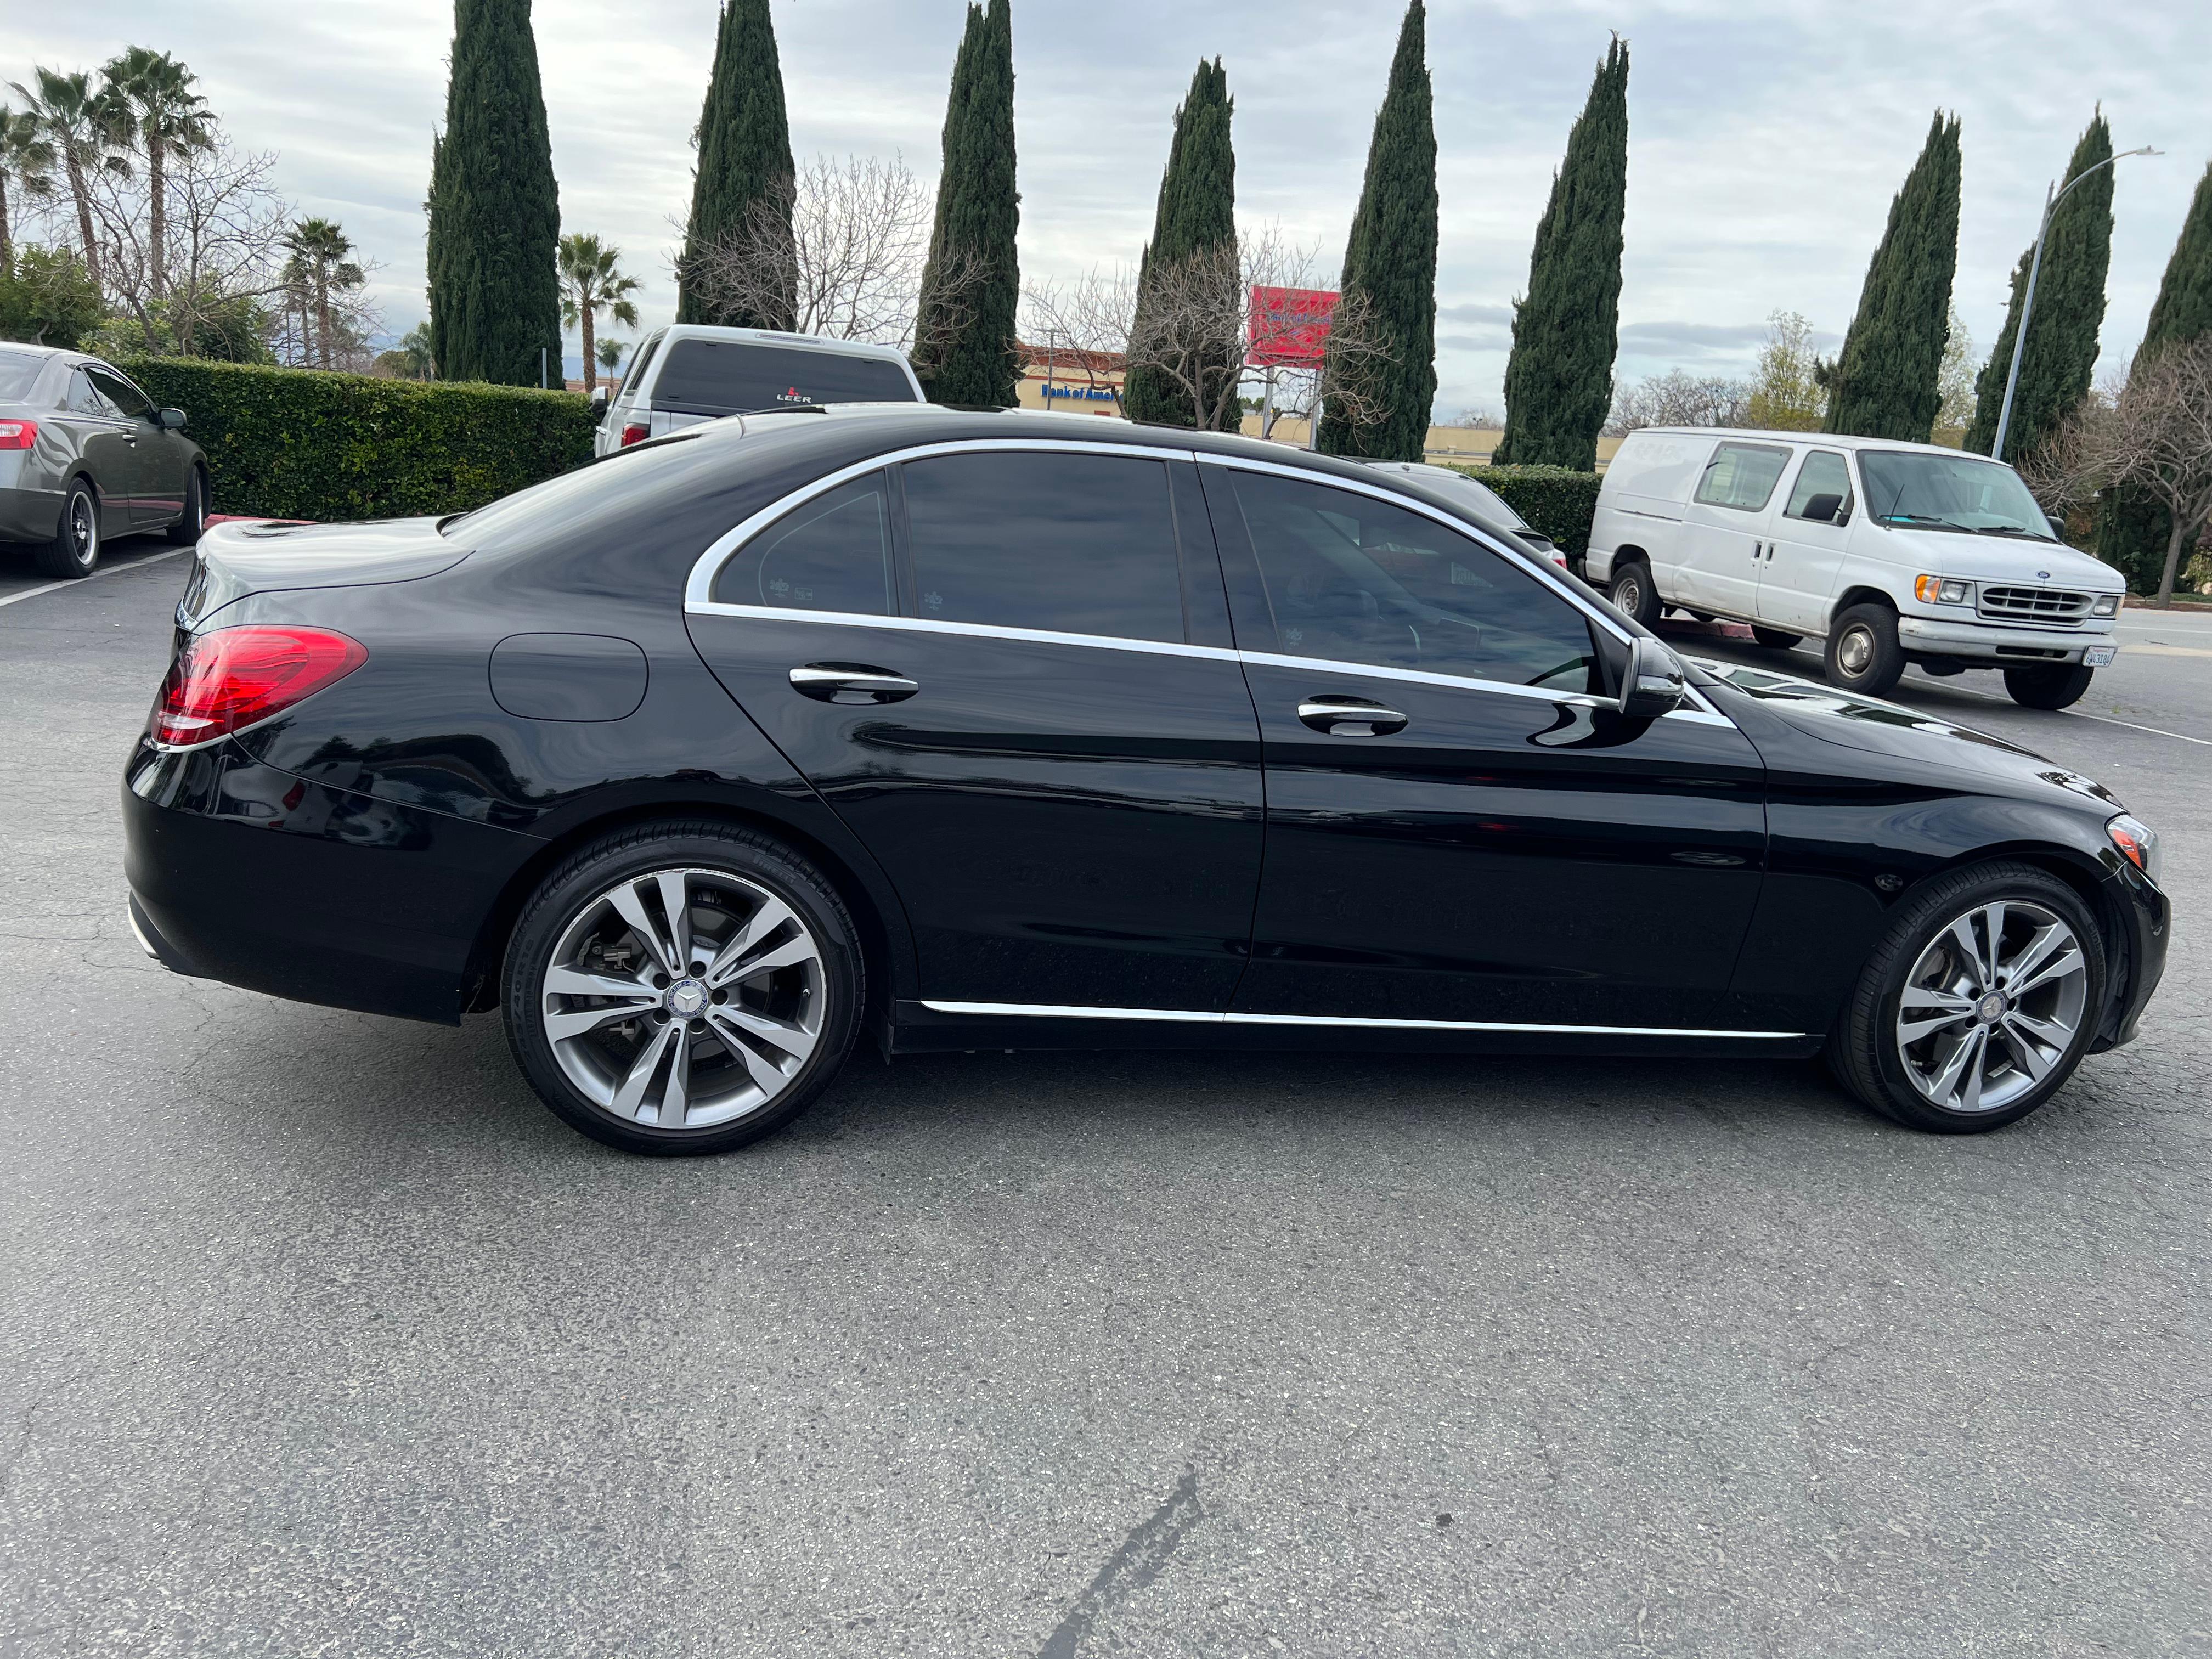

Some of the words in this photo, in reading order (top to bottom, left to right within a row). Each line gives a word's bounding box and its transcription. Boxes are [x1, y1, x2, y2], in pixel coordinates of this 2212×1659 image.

[1042, 385, 1070, 398] Bank
[1072, 387, 1084, 399] of
[776, 394, 811, 403] LEER
